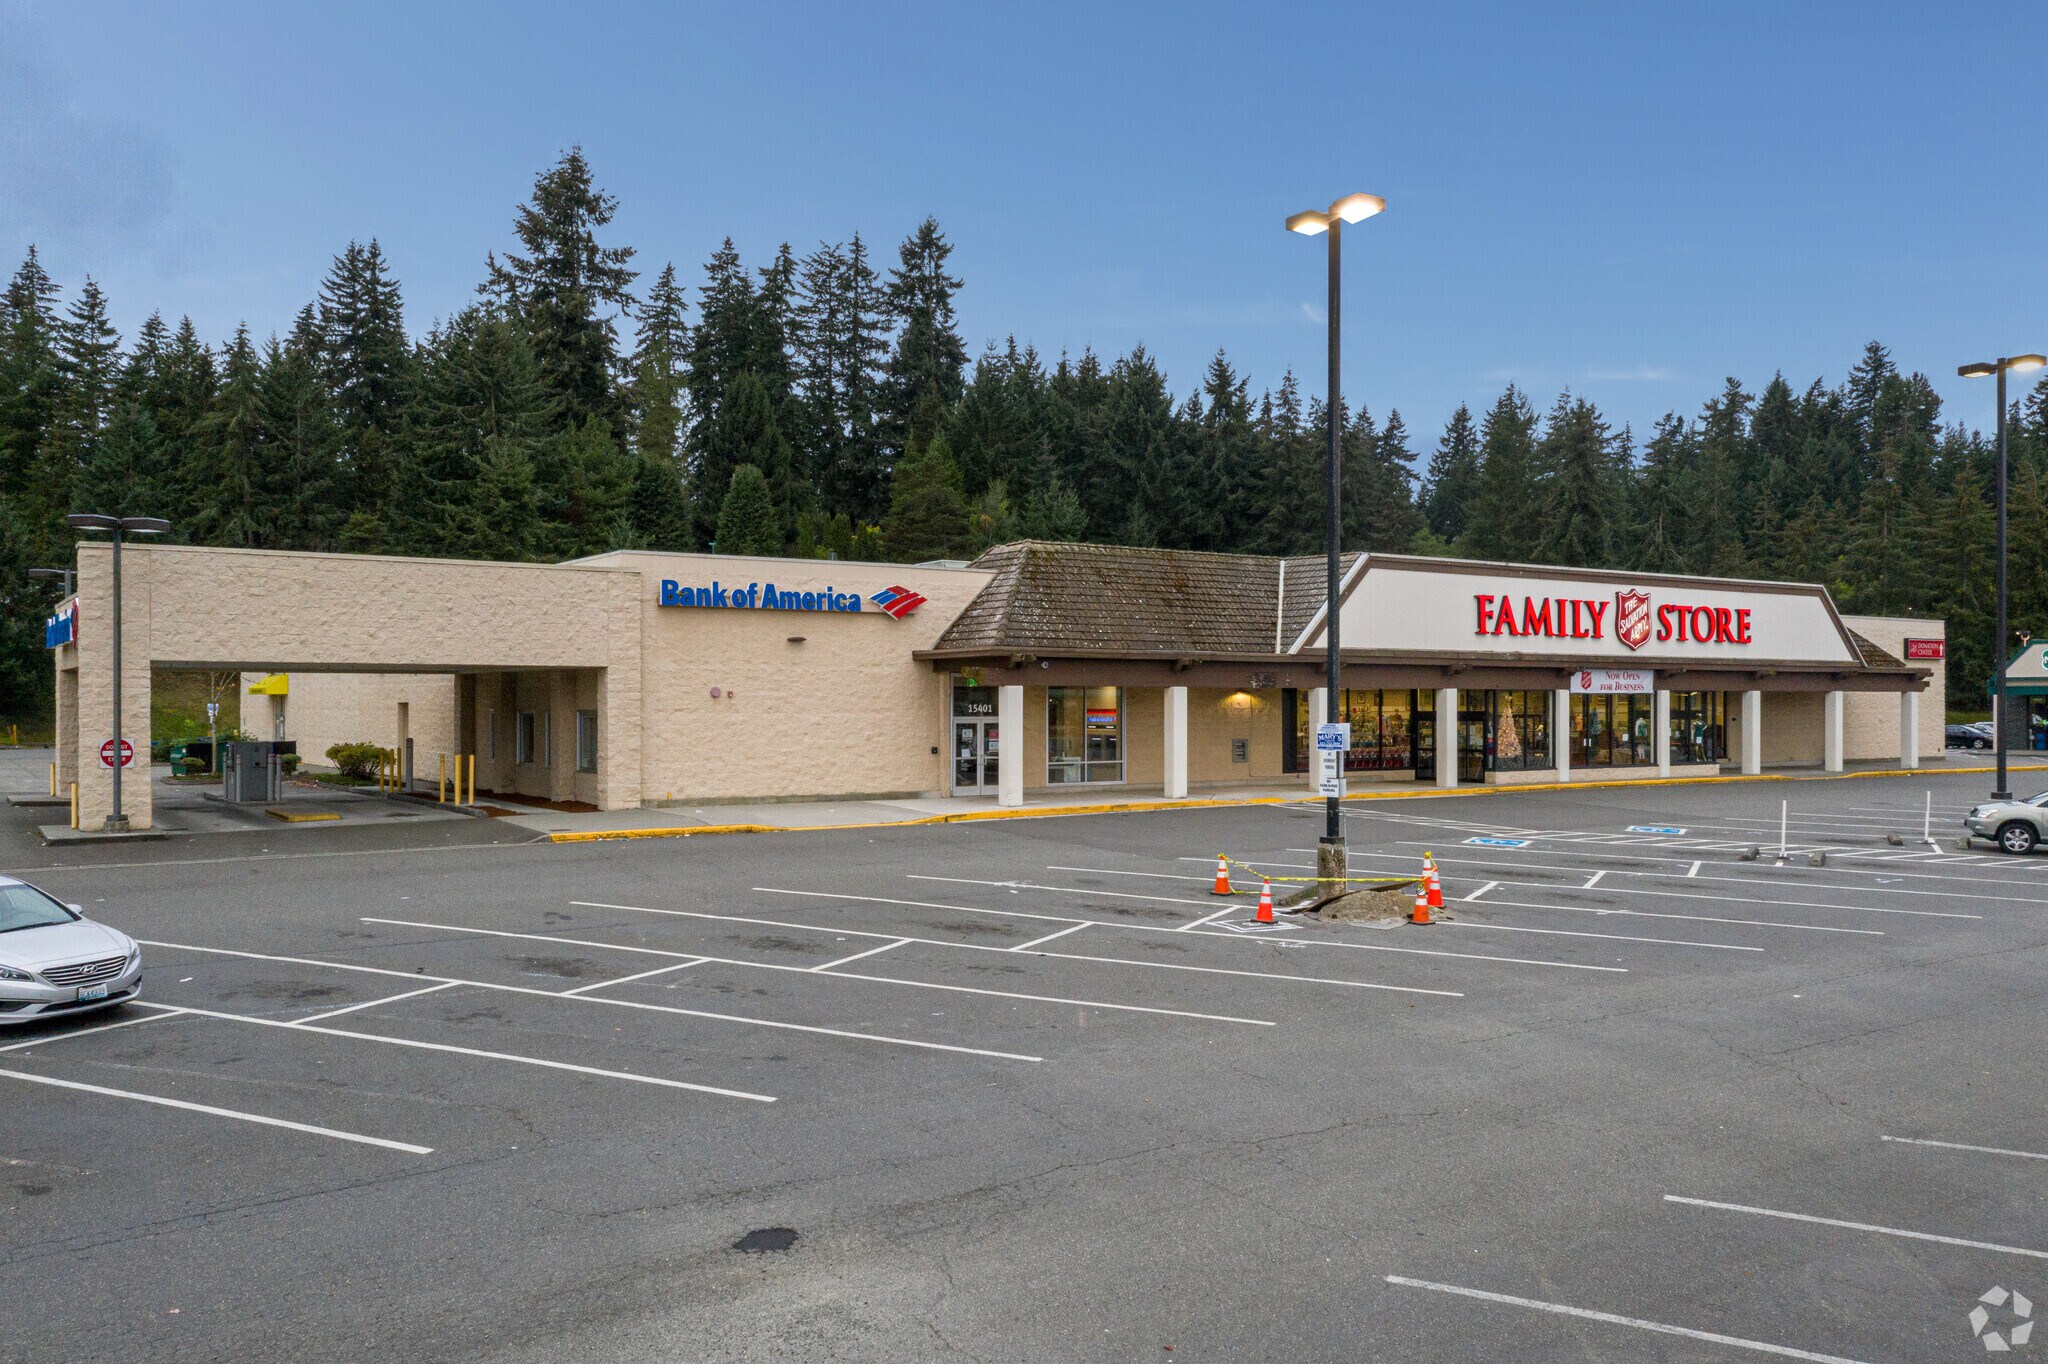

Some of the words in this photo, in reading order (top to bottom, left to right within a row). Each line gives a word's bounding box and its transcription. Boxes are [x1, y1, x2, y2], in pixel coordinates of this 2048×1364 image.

[660, 579, 728, 608] Bank
[731, 582, 758, 609] of
[761, 583, 862, 613] America
[1624, 596, 1638, 615] THE
[1474, 594, 1610, 639] FAMILY
[1620, 600, 1648, 634] SALVATION
[1657, 603, 1752, 645] STORE
[968, 703, 993, 714] 15401
